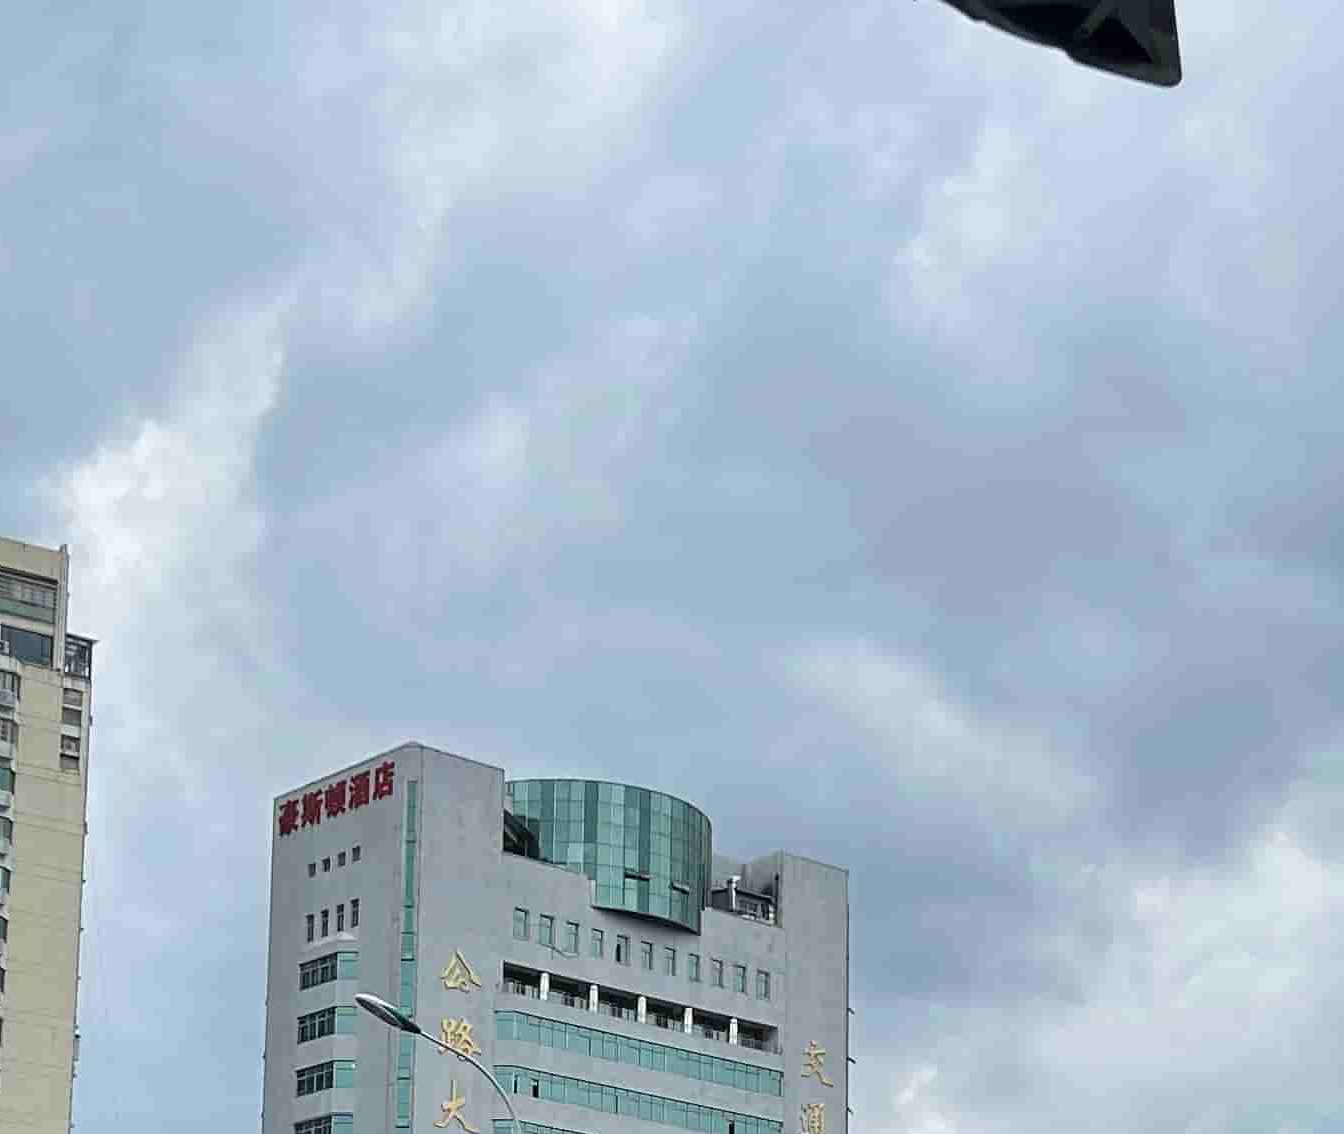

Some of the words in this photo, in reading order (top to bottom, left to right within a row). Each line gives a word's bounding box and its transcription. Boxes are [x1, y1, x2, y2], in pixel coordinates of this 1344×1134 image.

[278, 761, 395, 837] 豪斯顿酒店
